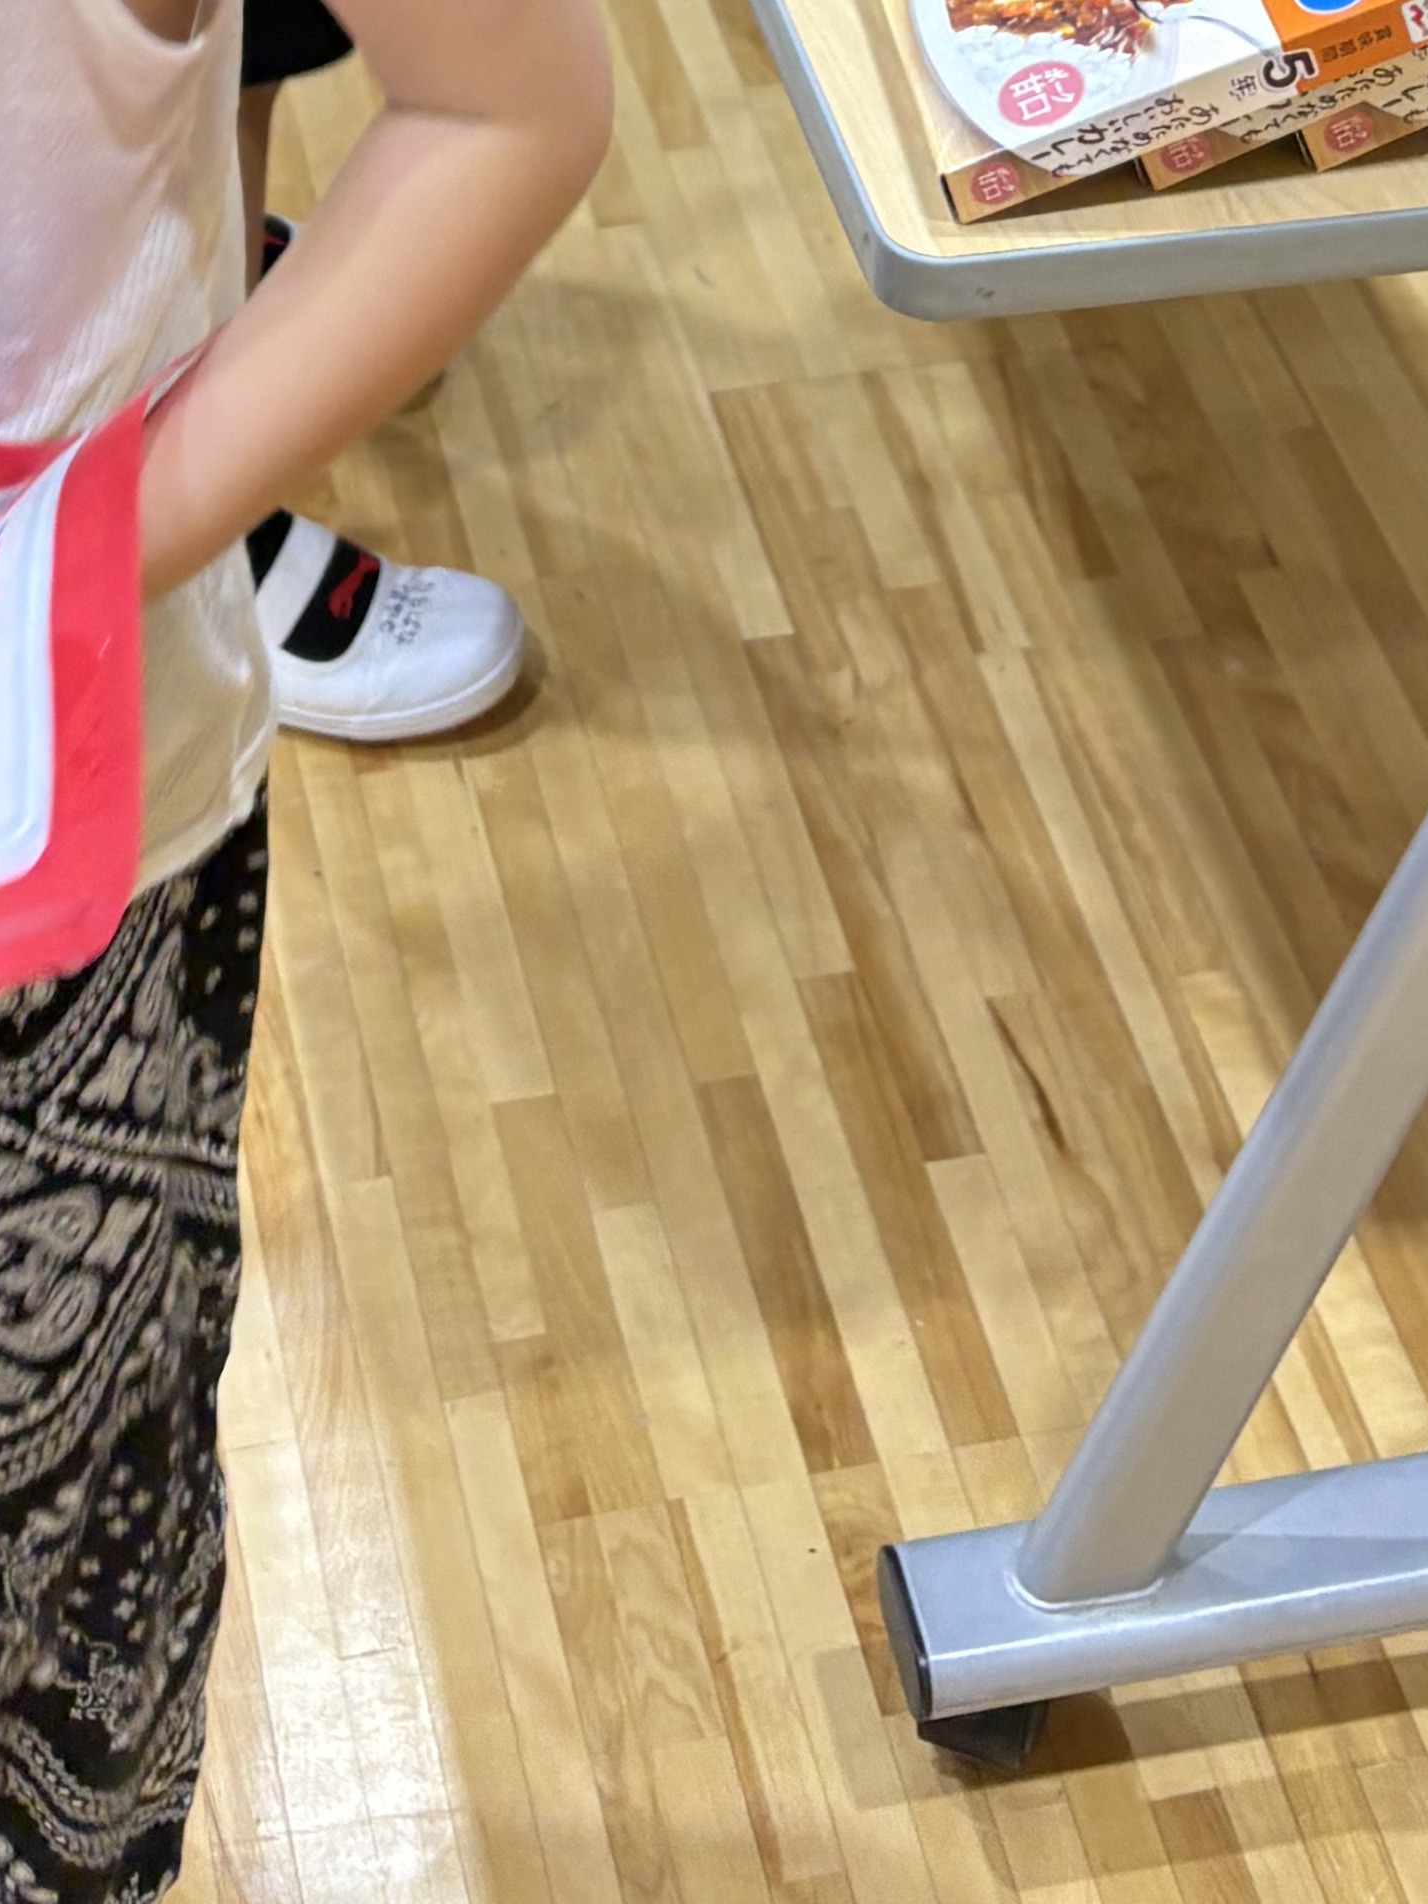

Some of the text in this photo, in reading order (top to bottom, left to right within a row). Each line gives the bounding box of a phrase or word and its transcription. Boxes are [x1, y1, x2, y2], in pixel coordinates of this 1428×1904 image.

[1011, 71, 1052, 122] 甘口
[1042, 67, 1076, 108] ポーク
[1031, 93, 1184, 162] おいしいカレー
[1050, 103, 1220, 178] あたためなくても
